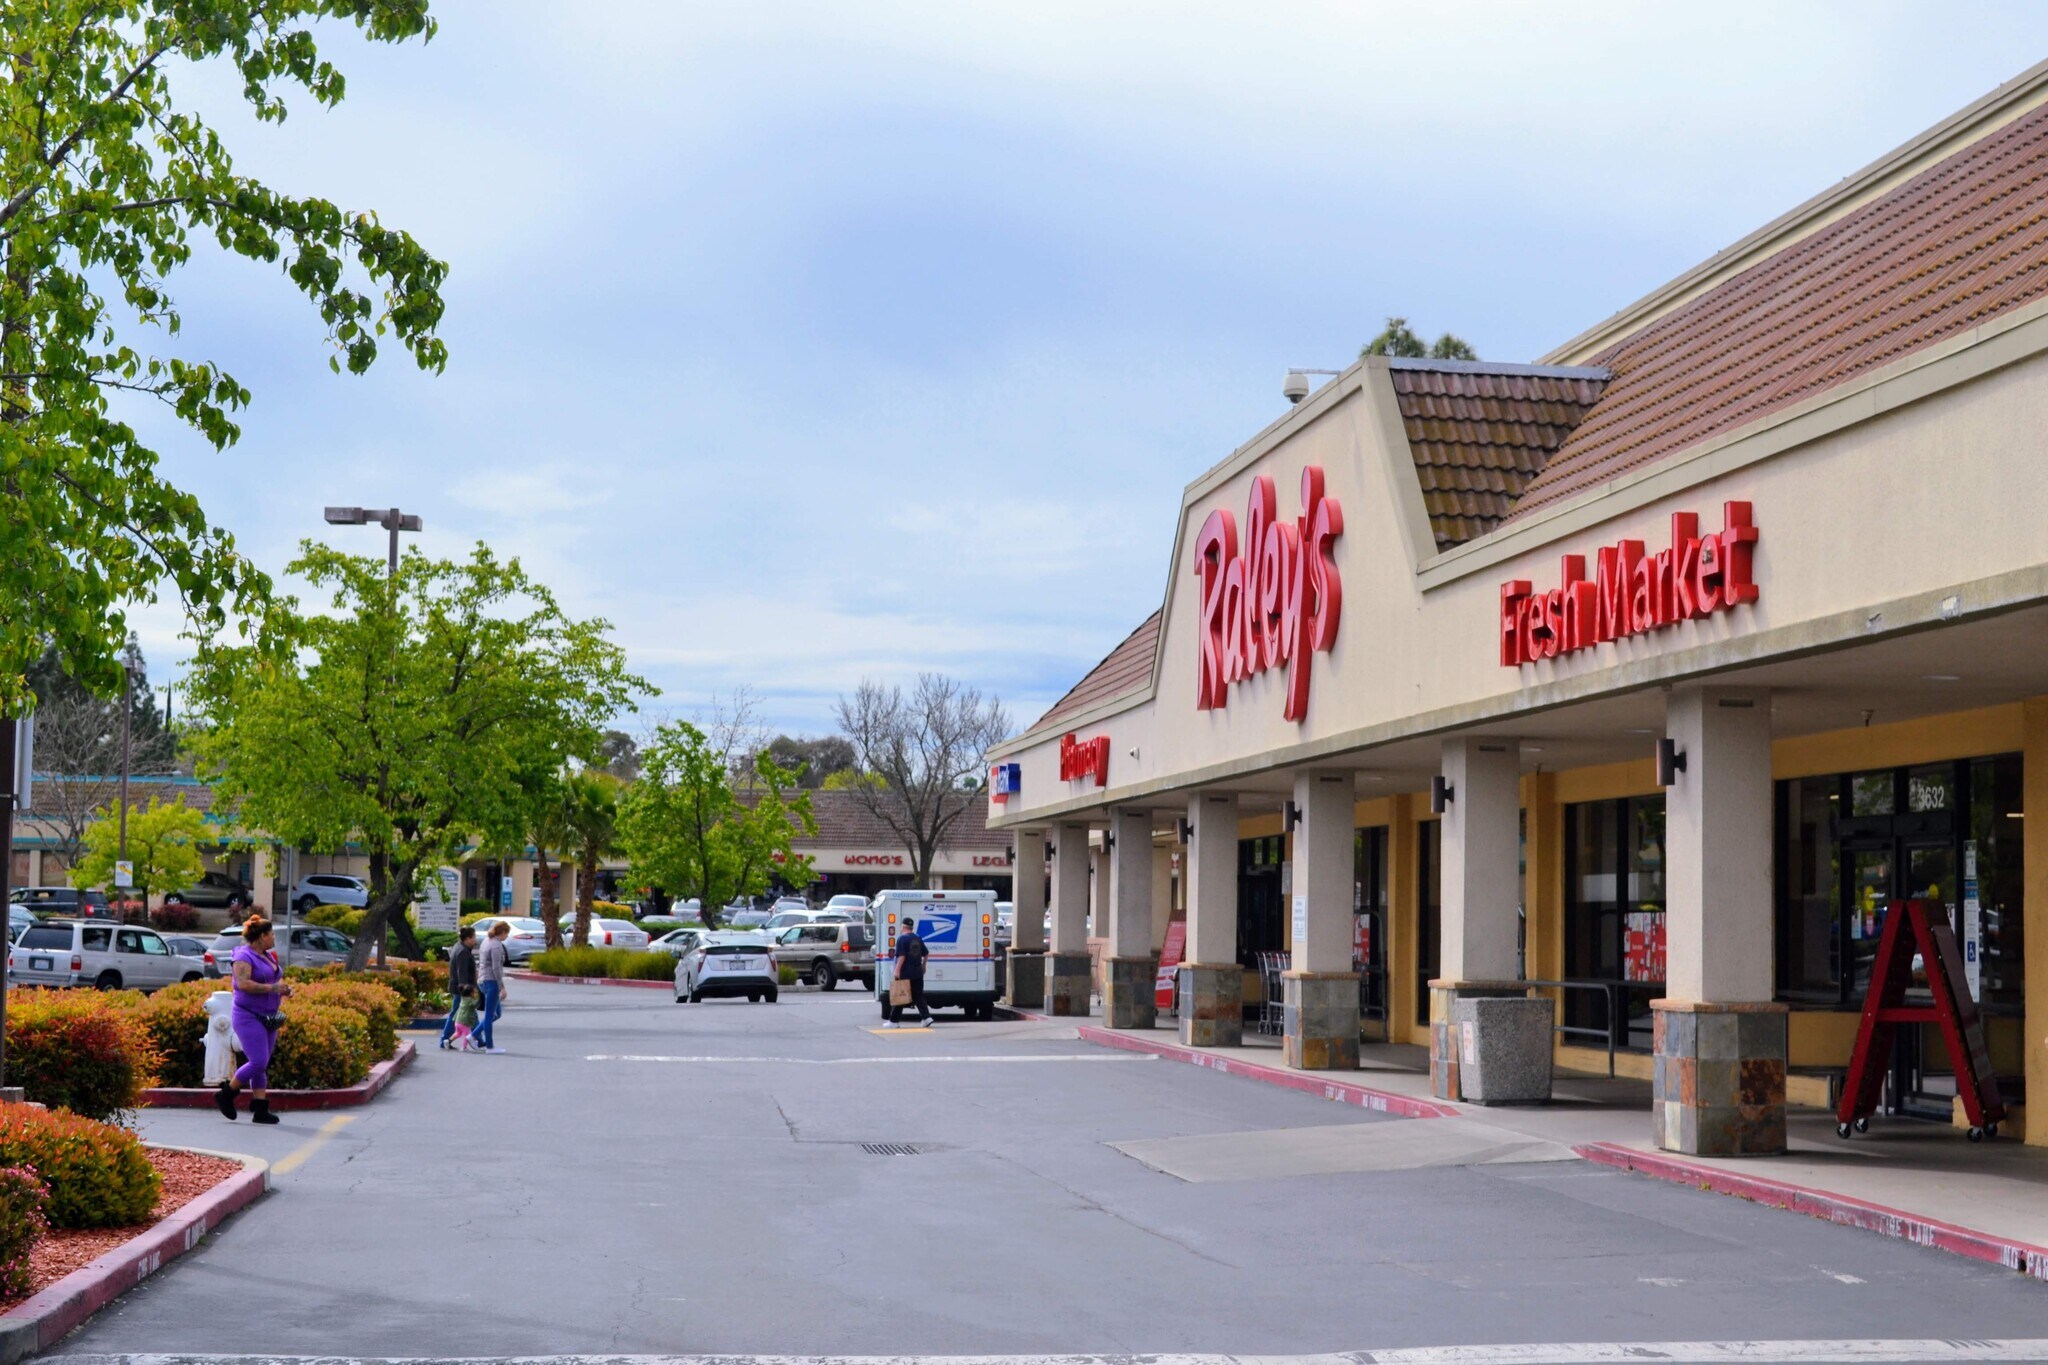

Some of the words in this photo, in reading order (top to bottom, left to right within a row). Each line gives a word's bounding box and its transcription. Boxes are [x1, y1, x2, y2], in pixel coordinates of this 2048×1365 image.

[1195, 465, 1343, 722] Raley's
[1501, 555, 1597, 667] Fresh
[1593, 501, 1758, 643] Market
[1918, 785, 1945, 809] 3632
[1908, 1221, 1936, 1247] LANE
